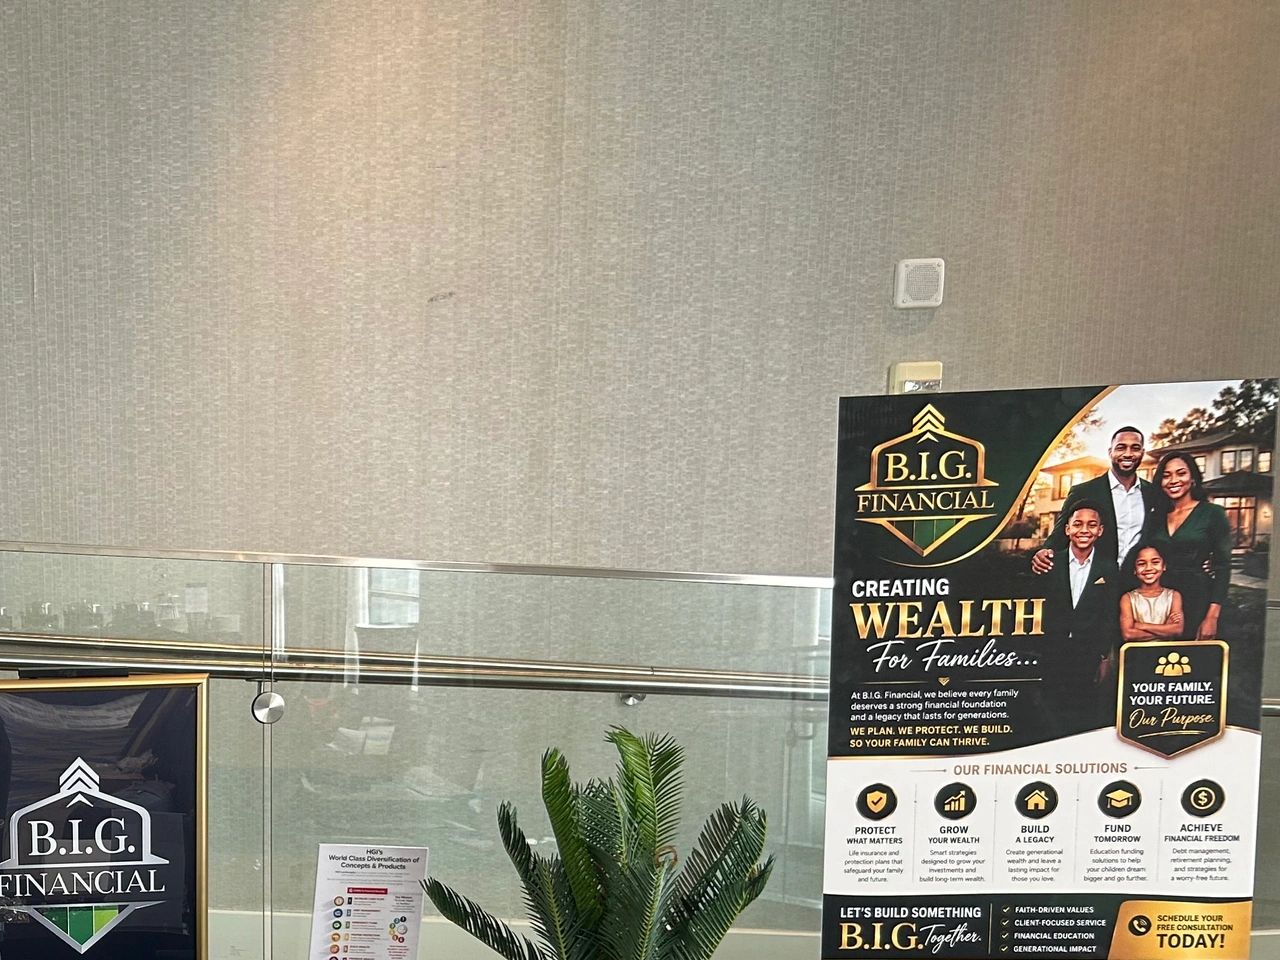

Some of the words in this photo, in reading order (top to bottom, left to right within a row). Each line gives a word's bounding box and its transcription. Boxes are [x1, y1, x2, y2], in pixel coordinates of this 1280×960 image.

[884, 450, 972, 482] B.I.G.
[856, 490, 995, 513] FINANCIAL
[852, 578, 950, 598] CREATING
[850, 598, 1046, 639] WEALTH
[866, 640, 913, 673] For
[916, 639, 1038, 672] Families...
[1132, 683, 1165, 692] YOUR
[1168, 682, 1213, 692] FAMILY.
[884, 691, 922, 699] Financial,
[938, 690, 966, 698] believe
[969, 691, 991, 699] every
[994, 689, 1019, 698] family
[1129, 696, 1163, 705] YOUR
[1165, 695, 1215, 704] FUTURE.
[851, 702, 887, 710] deserves
[897, 703, 922, 711] strong
[875, 713, 902, 722] legacy
[958, 712, 1009, 721] generations.
[1129, 708, 1158, 728] Our
[1160, 707, 1215, 729] Purpose.
[851, 727, 865, 735] WE
[868, 727, 895, 735] PLAN.
[916, 726, 961, 734] PROTECT.
[981, 725, 1013, 733] BUILD.
[850, 739, 863, 747] SO
[865, 739, 891, 747] YOUR
[894, 739, 926, 747] FAMILY
[929, 738, 950, 746] CAN
[952, 738, 990, 746] THRIVE.
[953, 764, 980, 776] OUR
[984, 763, 1051, 776] FINANCIAL
[1055, 762, 1127, 775] SOLUTIONS
[940, 826, 968, 834] GROW
[1021, 825, 1050, 833] BUILD
[1180, 824, 1223, 832] ACHIEVE
[28, 817, 135, 856] B.I.G.
[840, 907, 871, 918] LET'S
[874, 907, 908, 918] BUILD
[911, 907, 981, 918] SOMETHING
[839, 922, 924, 950] B.I.G.
[920, 922, 981, 954] Together.
[1157, 934, 1225, 948] TODAY!
